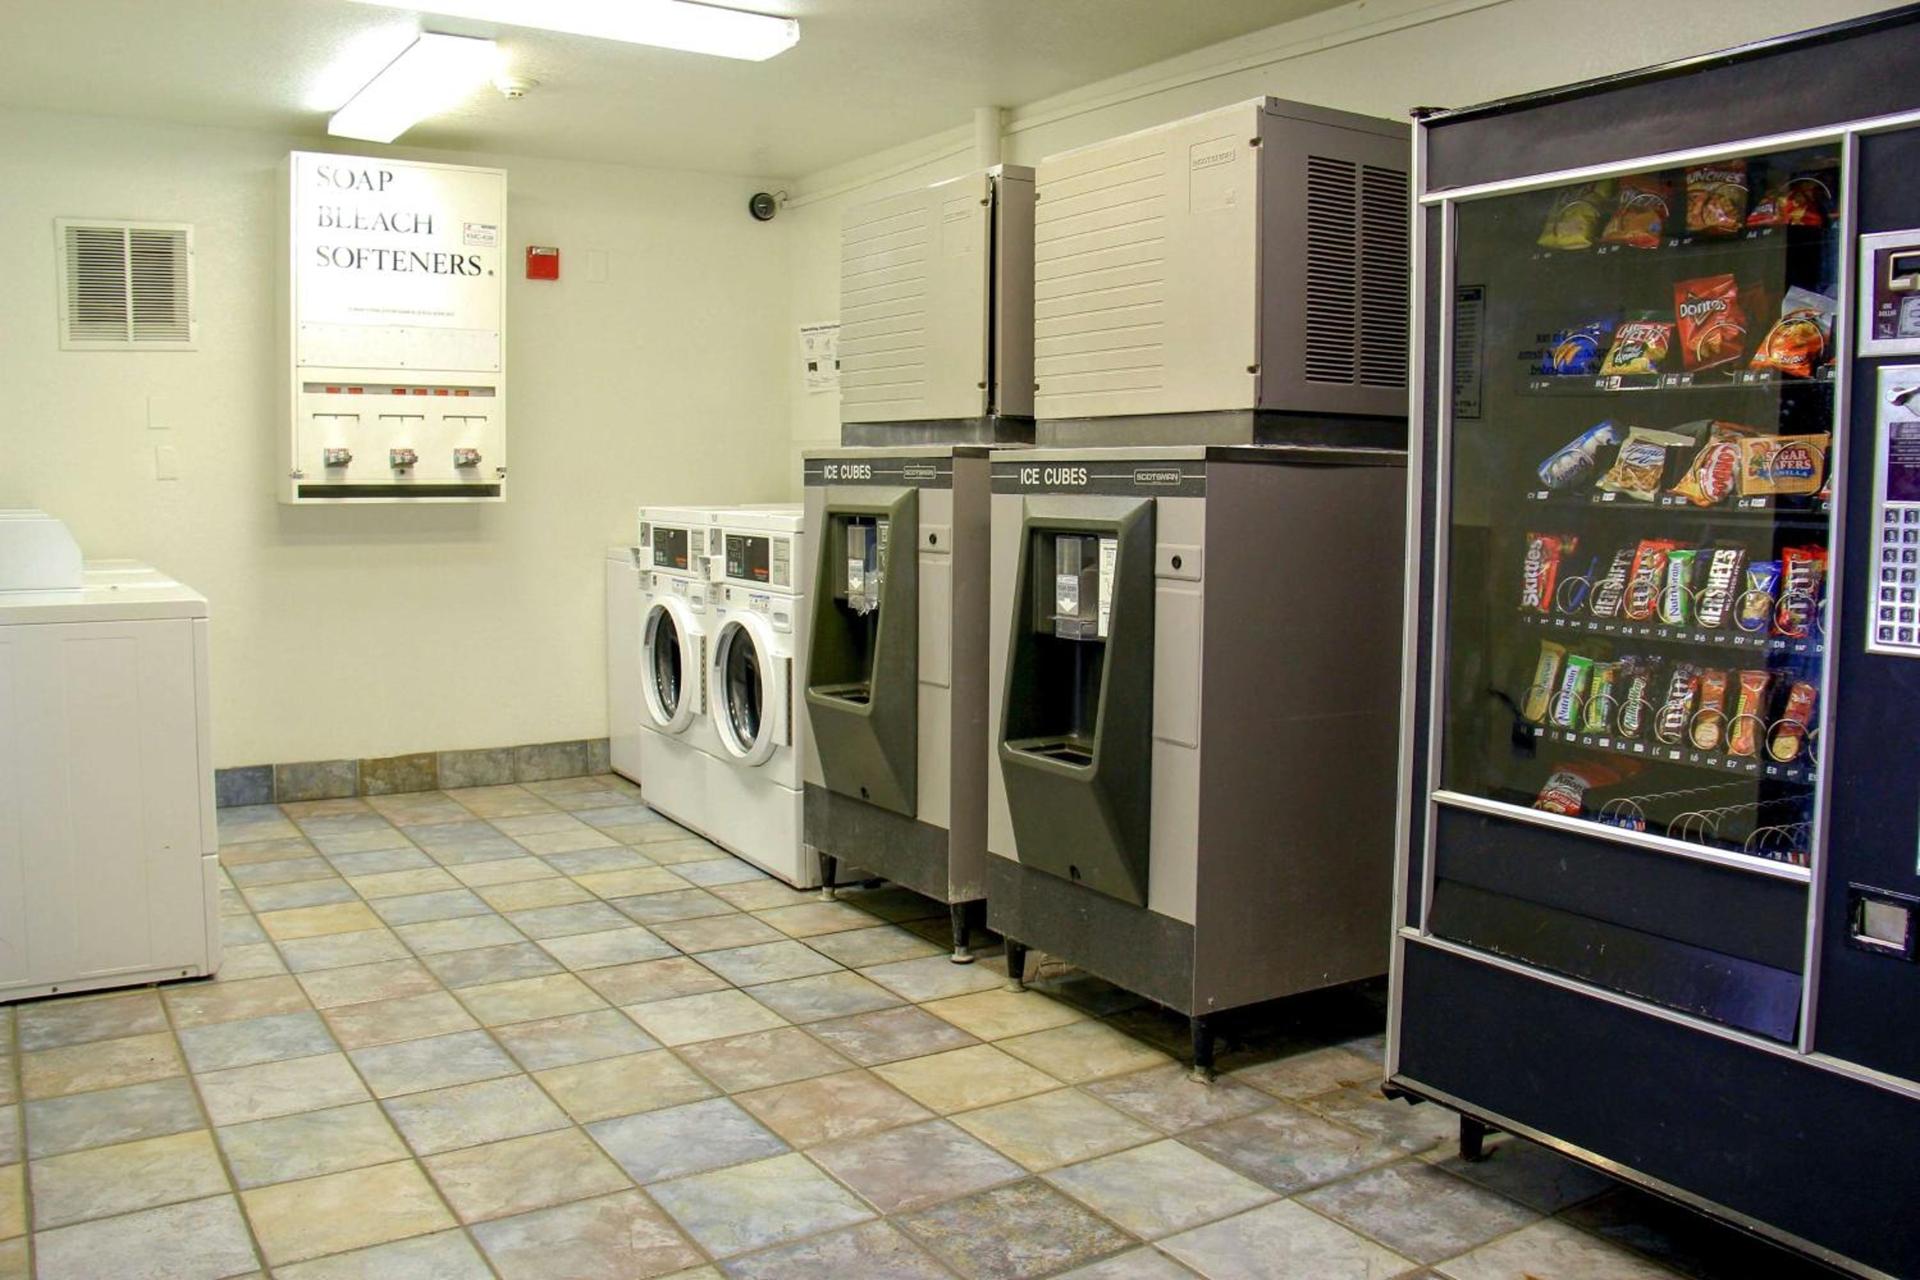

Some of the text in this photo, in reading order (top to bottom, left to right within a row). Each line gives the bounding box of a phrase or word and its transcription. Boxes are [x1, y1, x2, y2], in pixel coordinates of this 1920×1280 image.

[316, 164, 393, 192] SOAP
[317, 205, 434, 235] BLEACH
[1679, 299, 1727, 318] Doritos
[1764, 449, 1808, 461] SUGAR
[824, 465, 872, 480] ICE CUBES
[1761, 460, 1812, 471] WAFERS
[1020, 467, 1088, 486] ICE CUBES
[1136, 473, 1179, 481] SCOTSMAN
[1700, 550, 1737, 625] HERSHEY'S
